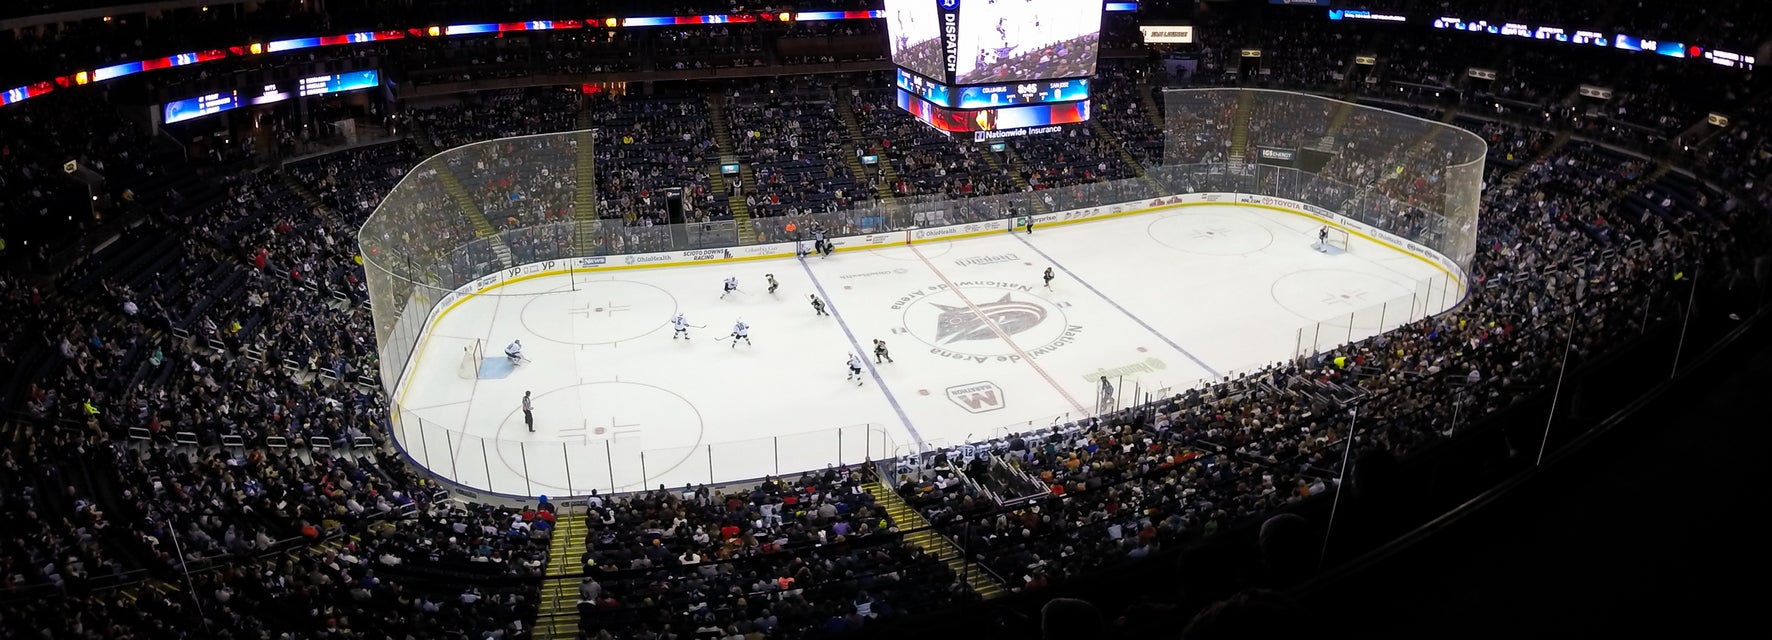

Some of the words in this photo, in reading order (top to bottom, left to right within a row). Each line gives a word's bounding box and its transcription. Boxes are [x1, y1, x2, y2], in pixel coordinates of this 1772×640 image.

[944, 13, 957, 72] DISPATCH
[982, 86, 1007, 94] COLUMBUS
[1017, 83, 1038, 94] 8:45
[985, 128, 1026, 139] Nationwide
[1028, 125, 1062, 135] Insurance
[1274, 200, 1301, 210] TOYOTA
[926, 228, 957, 237] OhioHealth
[637, 255, 672, 263] OhioHealth
[954, 253, 1020, 267] Dispatch
[541, 260, 555, 271] yp
[508, 267, 521, 278] yp
[891, 290, 925, 311] Arena
[930, 347, 986, 364] Arena
[952, 385, 992, 395] MARATHON
[965, 448, 973, 457] 12
